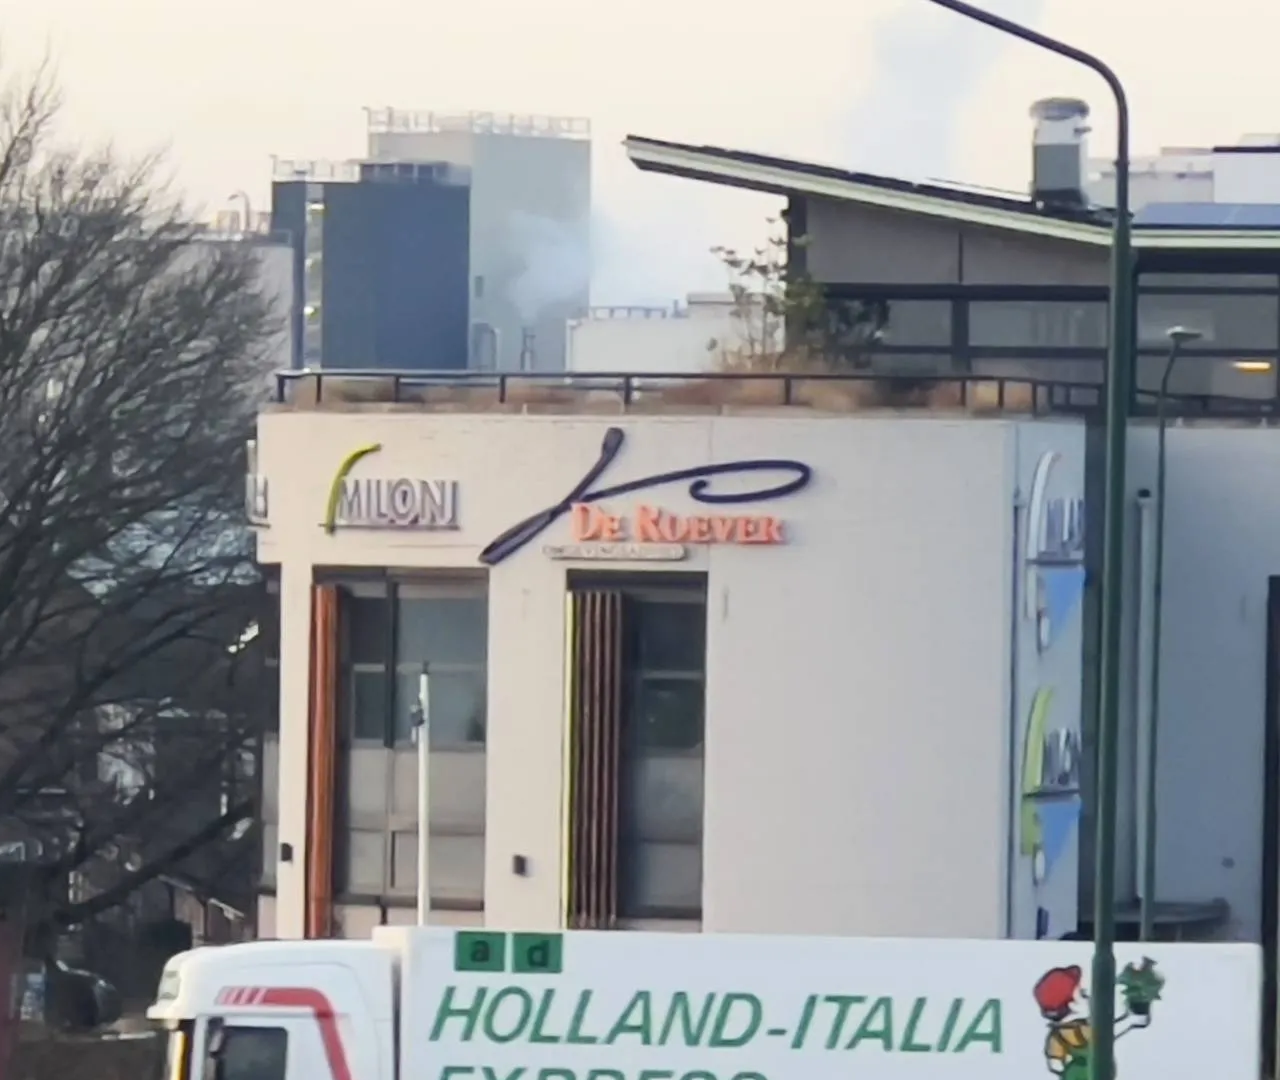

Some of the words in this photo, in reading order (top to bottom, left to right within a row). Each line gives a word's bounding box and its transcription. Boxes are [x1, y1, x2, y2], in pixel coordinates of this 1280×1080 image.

[635, 501, 787, 546] ROEVER
[470, 940, 491, 963] a
[526, 939, 551, 969] d
[428, 985, 1005, 1054] HOLLAND-ITALIA
